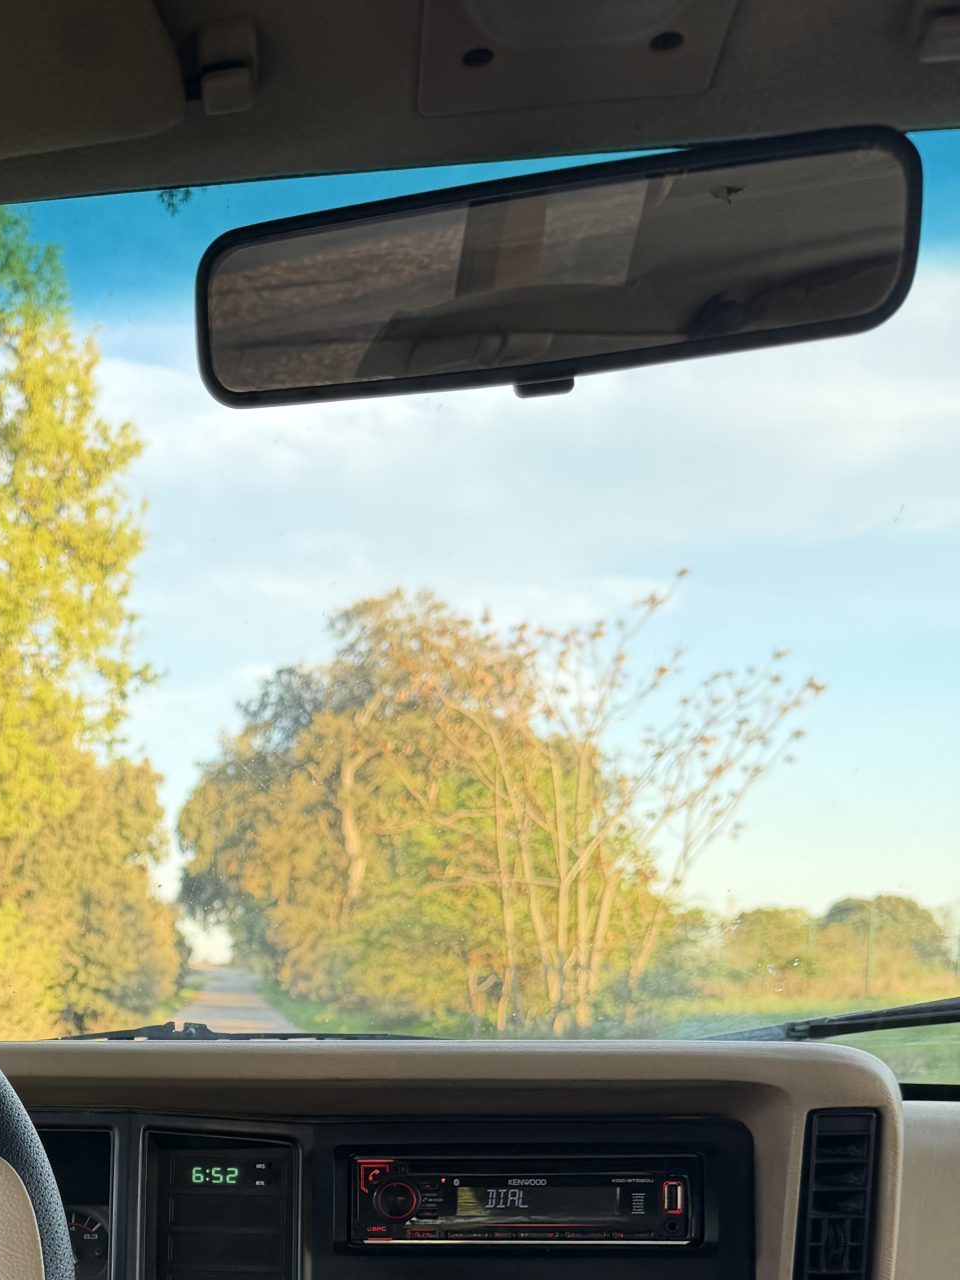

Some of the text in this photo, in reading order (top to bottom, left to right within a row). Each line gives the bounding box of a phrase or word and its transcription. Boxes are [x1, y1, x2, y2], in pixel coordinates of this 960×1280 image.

[191, 1166, 239, 1185] 6:52
[507, 1178, 547, 1187] KENWOOD
[485, 1188, 529, 1209] DIAL
